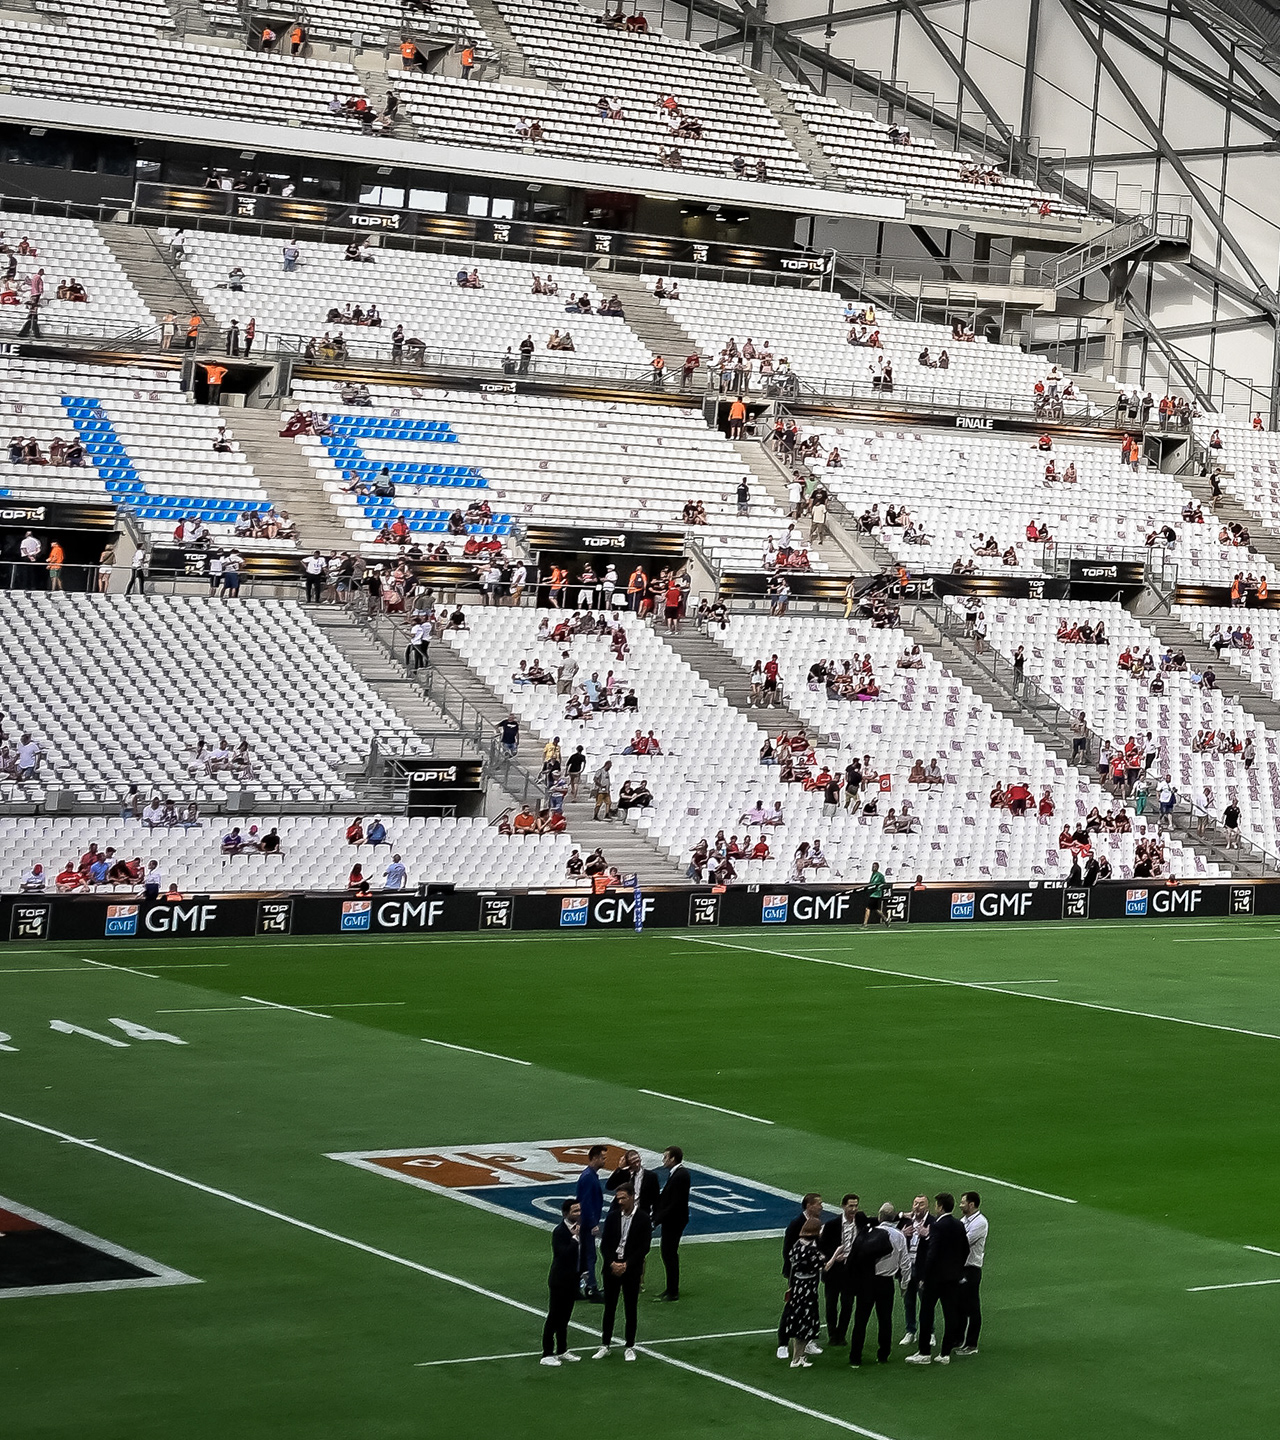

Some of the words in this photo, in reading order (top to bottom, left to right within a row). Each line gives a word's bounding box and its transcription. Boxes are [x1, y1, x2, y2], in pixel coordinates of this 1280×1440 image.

[956, 417, 994, 430] FINALE
[486, 900, 510, 909] TOP
[694, 898, 717, 906] TOP
[980, 892, 1033, 917] GMF
[1152, 889, 1202, 913] GMF
[262, 904, 289, 913] TOP
[793, 895, 850, 920] GMF
[953, 905, 973, 915] GMF
[1067, 906, 1085, 916] 14
[1127, 902, 1146, 911] GMF
[1233, 902, 1250, 912] 14
[18, 908, 46, 917] TOP
[377, 901, 444, 927] GMF
[563, 912, 586, 921] GMF
[695, 912, 714, 923] 14
[765, 909, 785, 918] GMF
[145, 905, 218, 932] GMF
[344, 916, 368, 926] GMF
[486, 915, 507, 926] 14
[18, 923, 42, 936] 14
[108, 921, 135, 931] GMF
[262, 919, 285, 932] 14
[50, 1018, 190, 1057] 14
